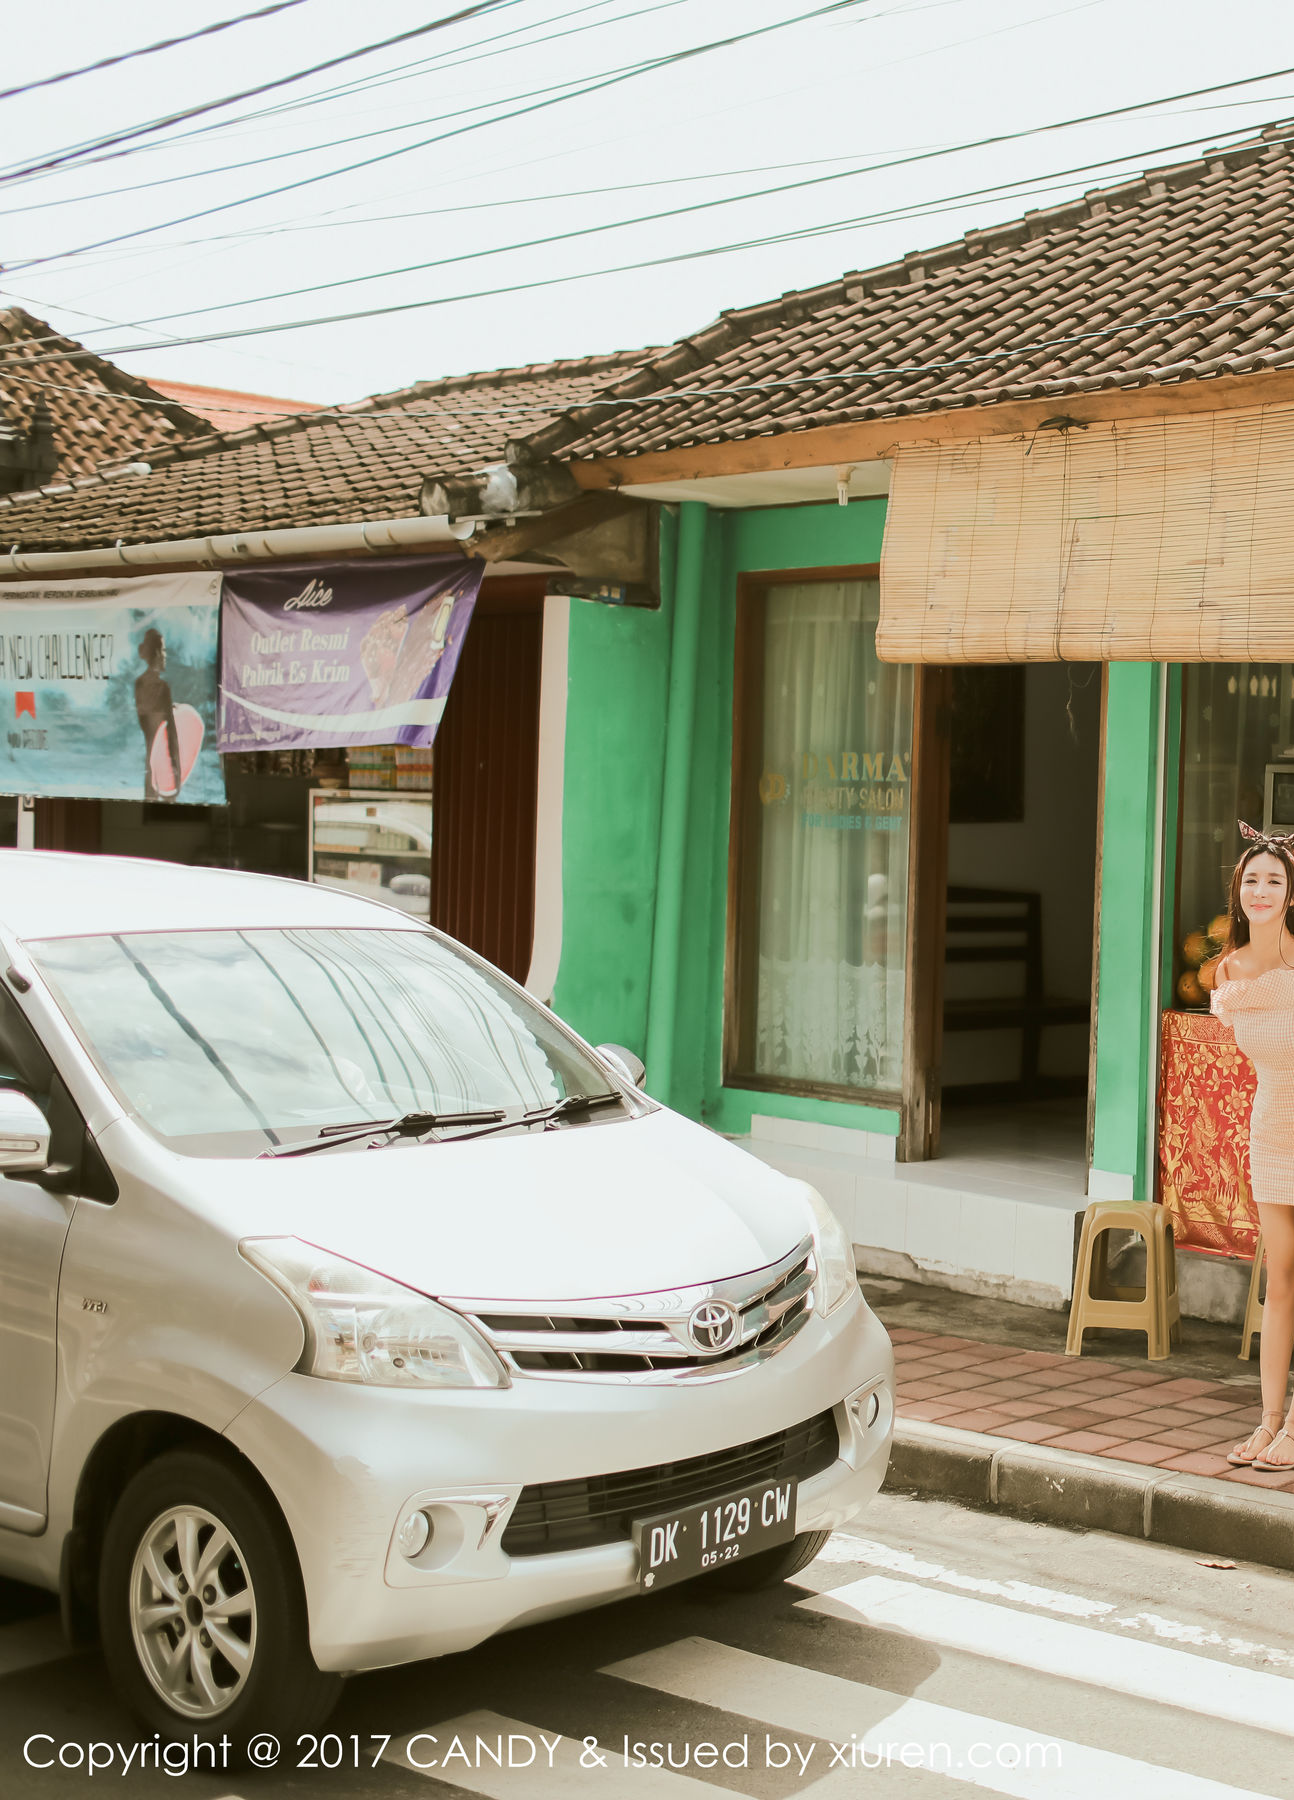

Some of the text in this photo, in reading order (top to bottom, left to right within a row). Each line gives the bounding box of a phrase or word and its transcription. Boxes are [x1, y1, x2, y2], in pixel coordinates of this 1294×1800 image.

[283, 579, 333, 611] Aice
[250, 627, 350, 655] Outlet Resmi
[241, 659, 350, 688] Pabrik Es Krim
[859, 787, 904, 810] SALON
[650, 1483, 791, 1568] DK 1129 CW
